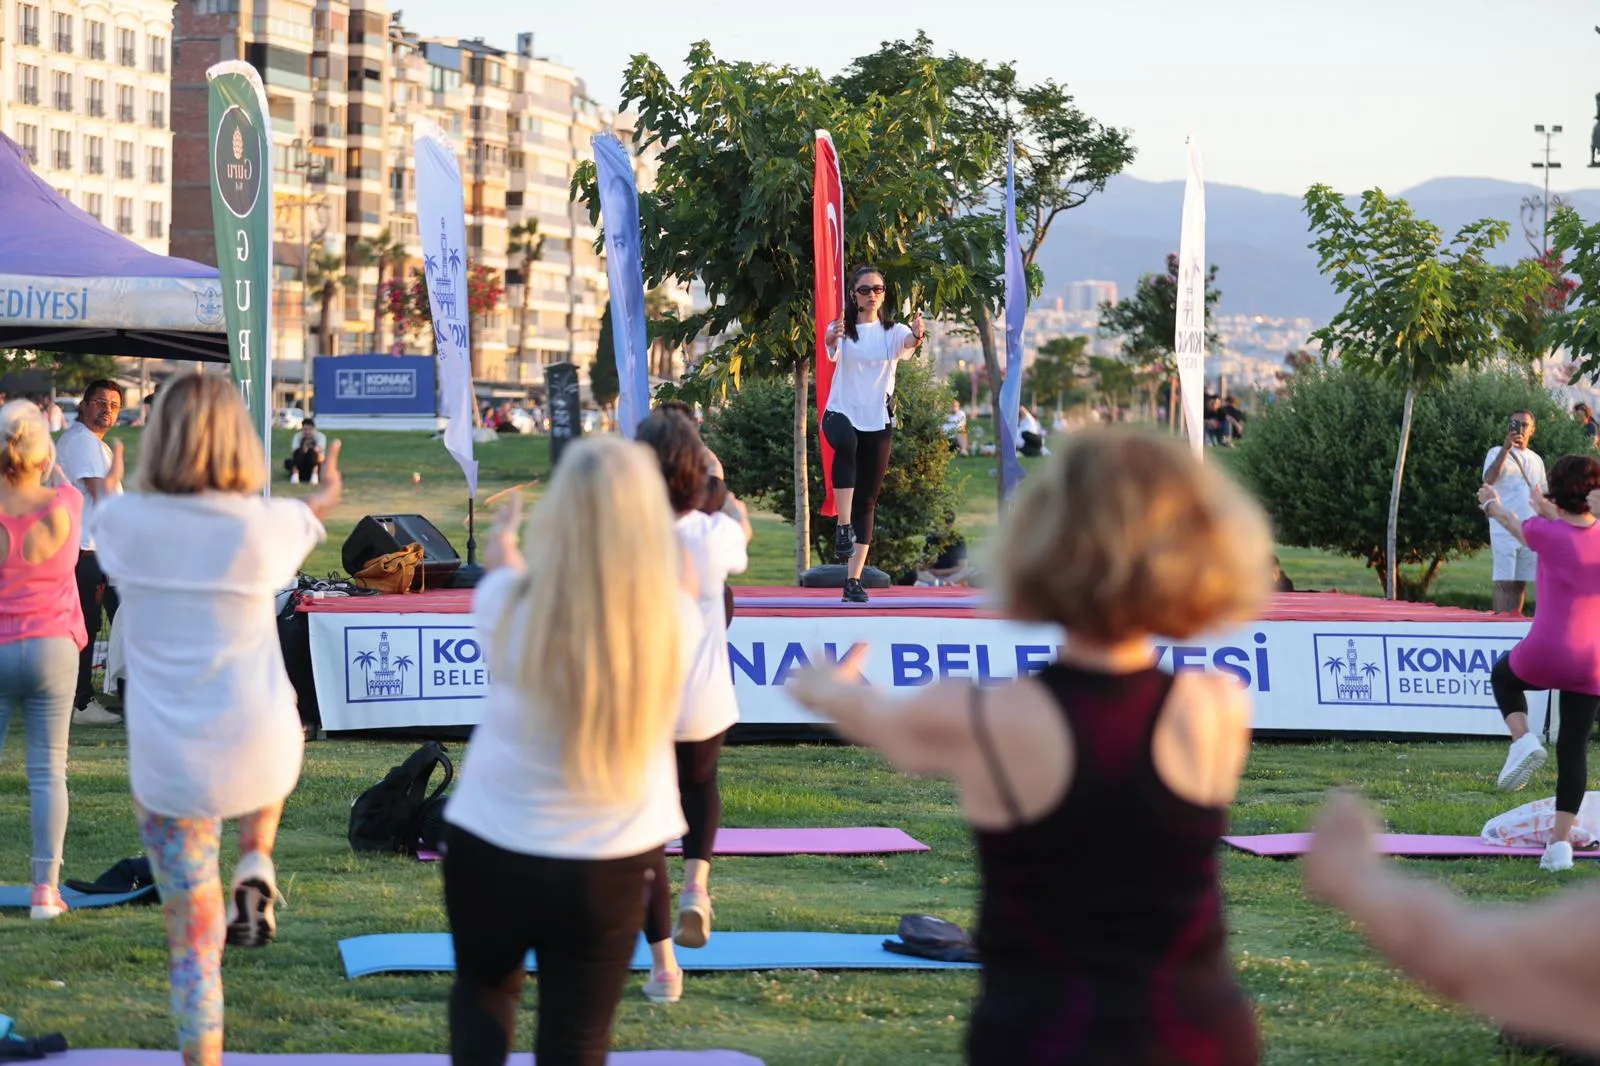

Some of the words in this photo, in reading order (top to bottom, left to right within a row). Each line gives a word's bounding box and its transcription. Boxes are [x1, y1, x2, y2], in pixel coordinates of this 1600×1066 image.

[366, 373, 411, 386] KONAK
[433, 638, 485, 664] KO
[433, 669, 491, 686] BELE
